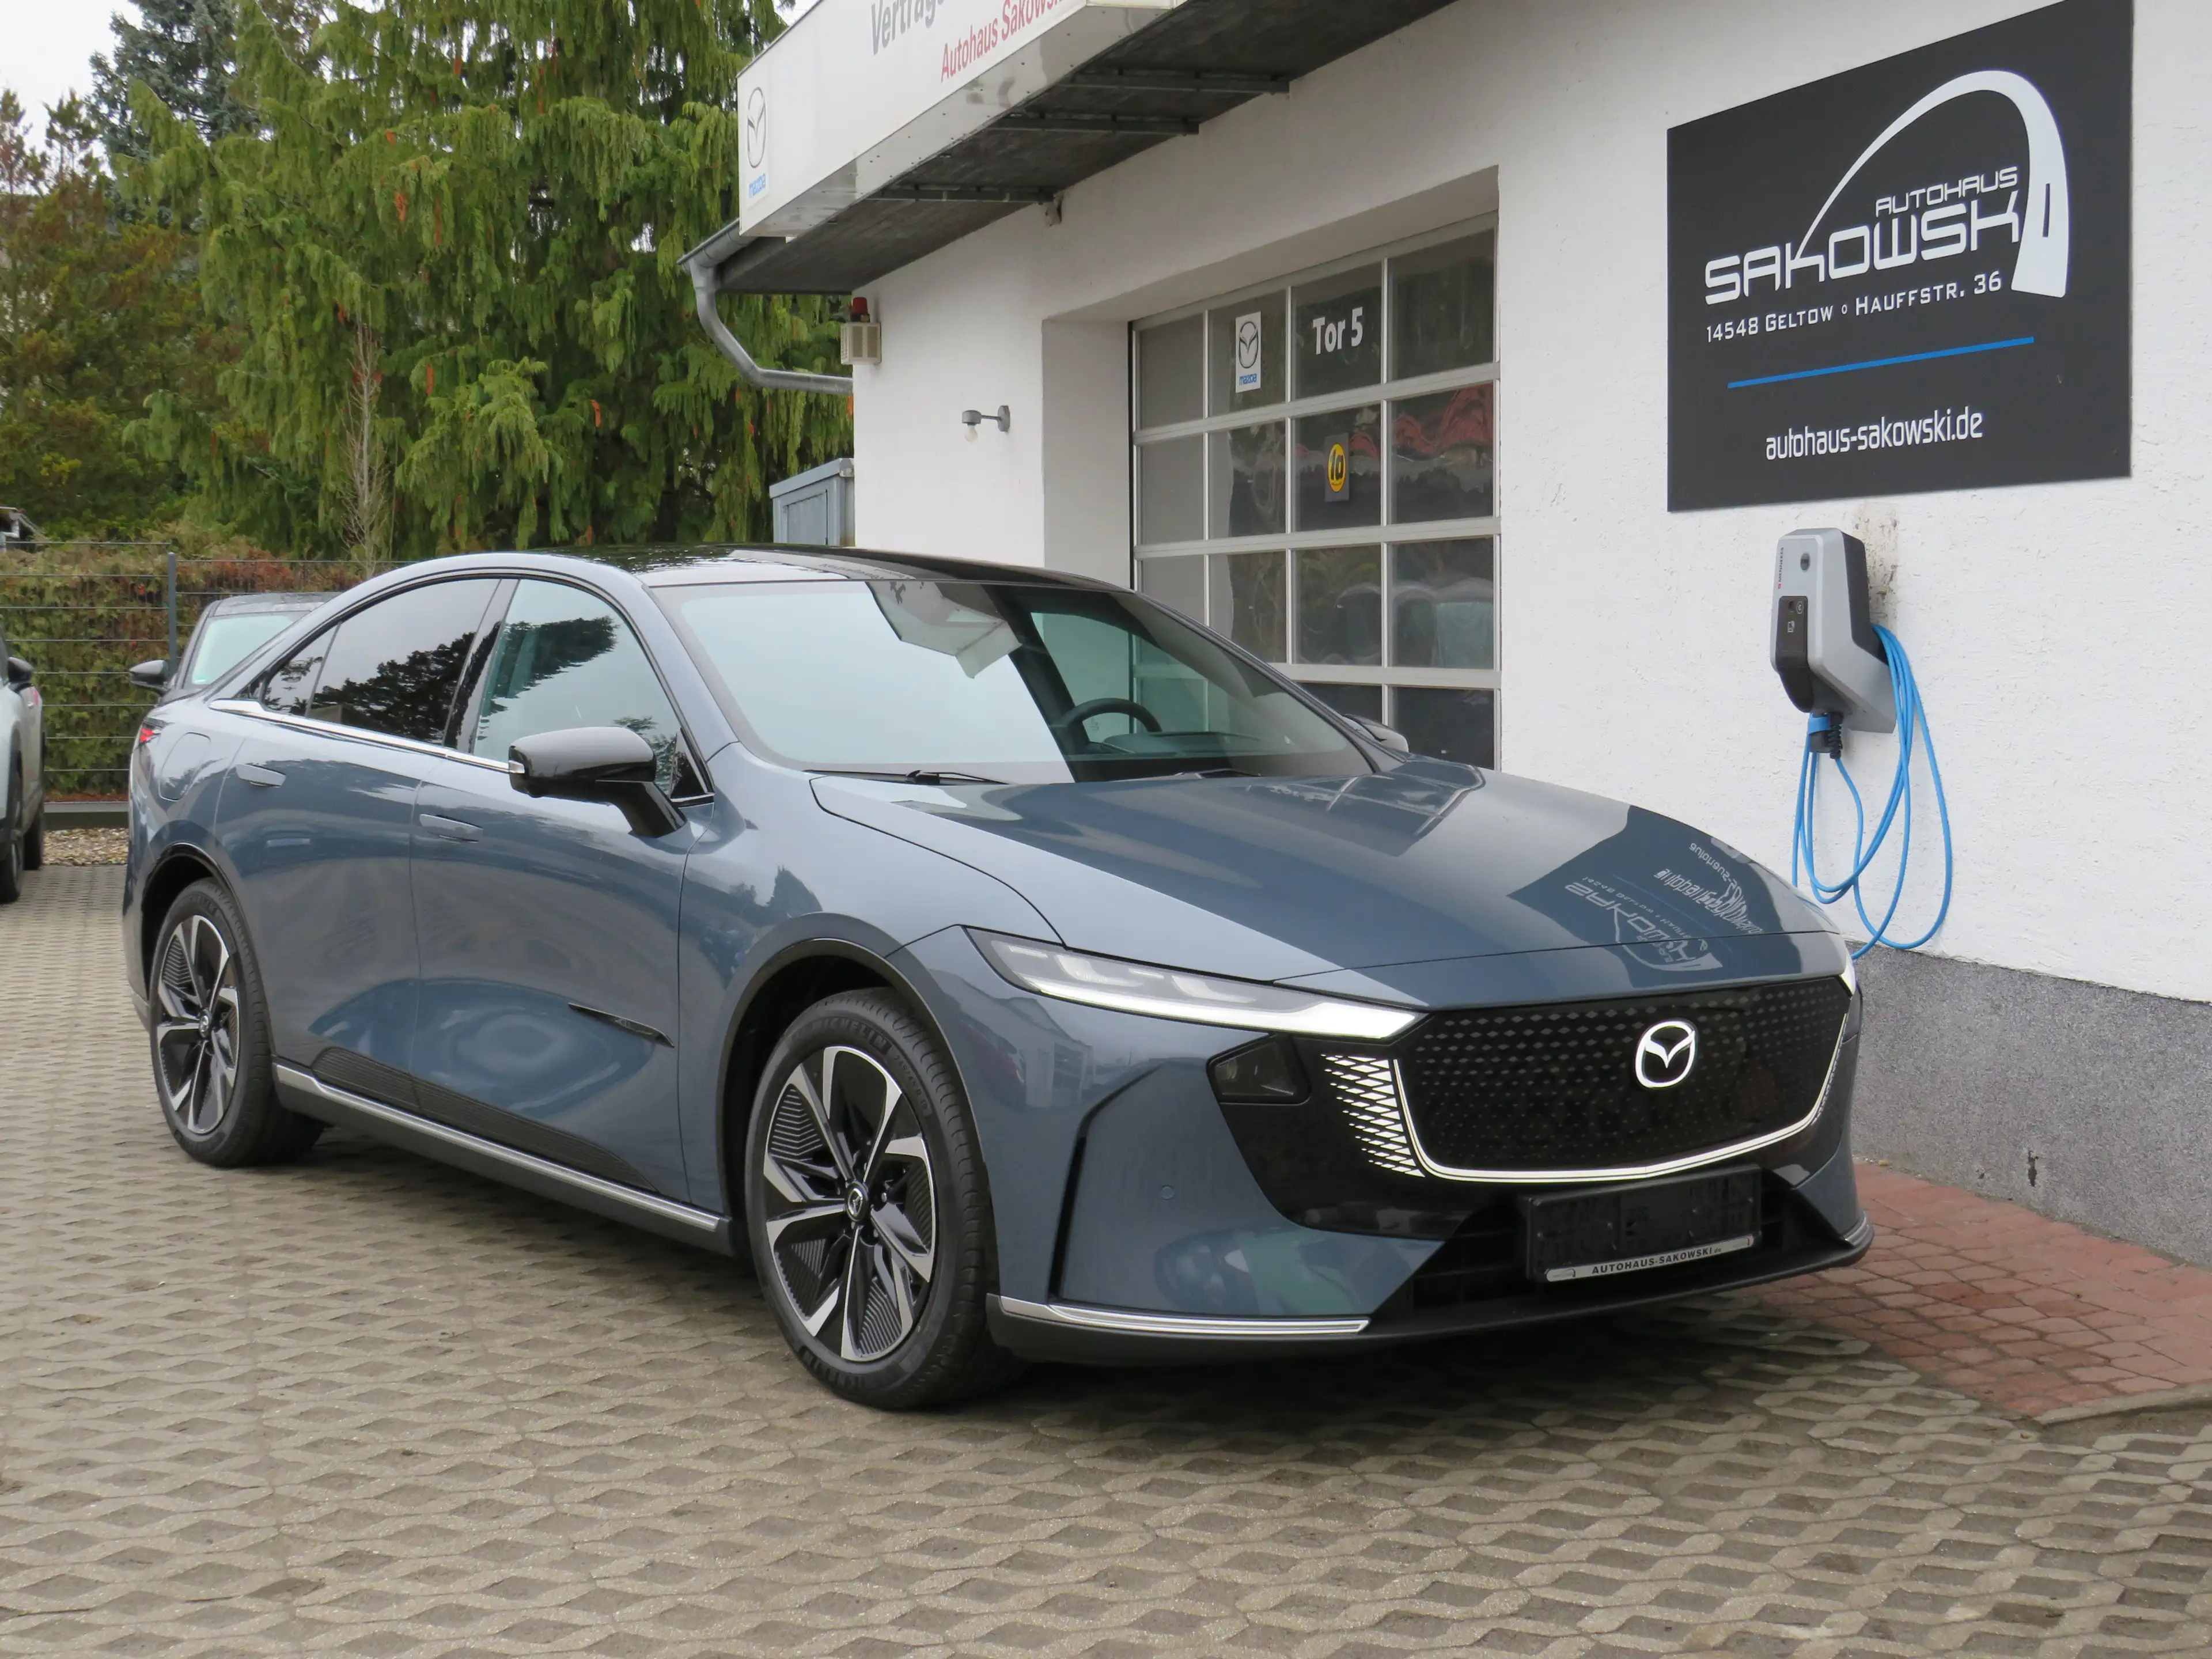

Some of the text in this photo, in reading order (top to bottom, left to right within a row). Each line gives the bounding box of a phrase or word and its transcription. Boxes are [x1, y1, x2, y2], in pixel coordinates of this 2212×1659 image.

[940, 18, 998, 84] Autohaus
[1876, 166, 2018, 217] AUTOHAUS
[1312, 306, 1363, 355] Tor 5
[1706, 317, 1759, 343] 14548
[1974, 271, 2002, 295] 36
[1239, 373, 1257, 385] mazda
[1766, 406, 1983, 460] autohaus-sakowski.de
